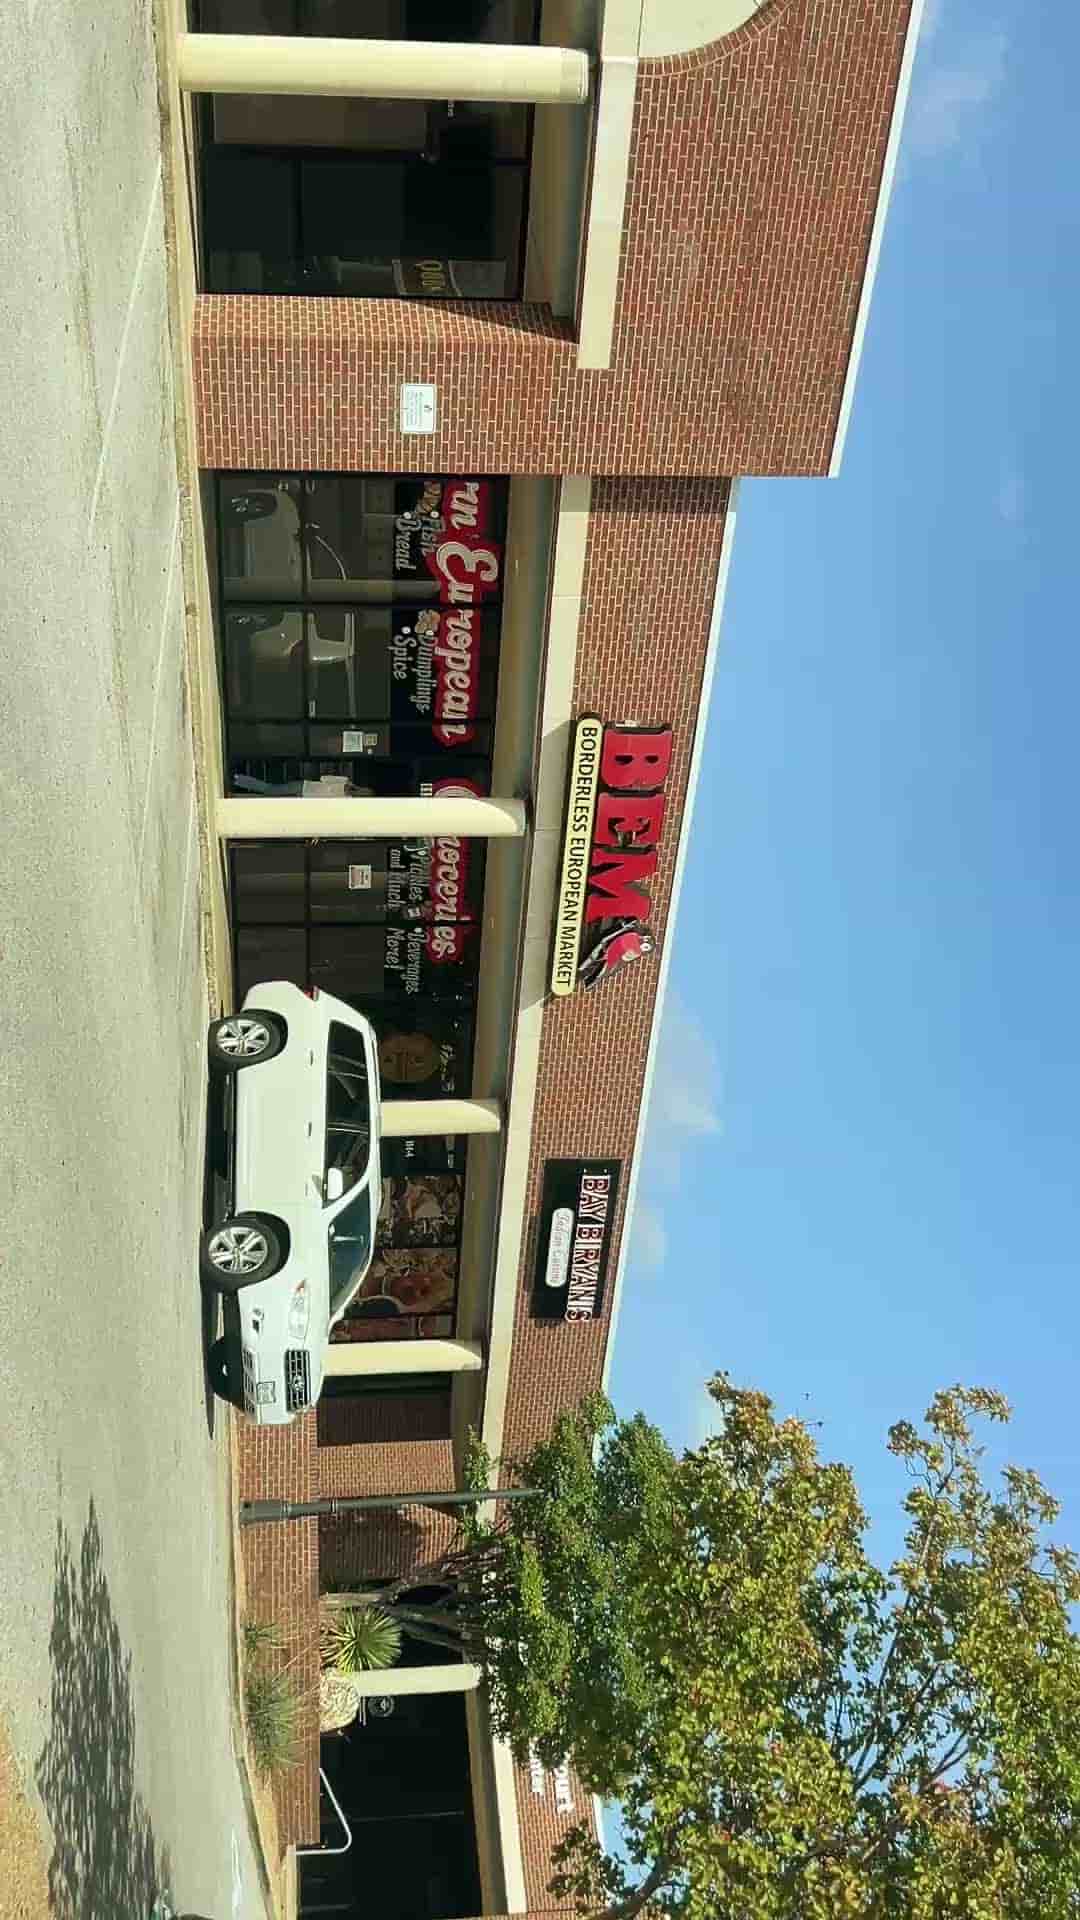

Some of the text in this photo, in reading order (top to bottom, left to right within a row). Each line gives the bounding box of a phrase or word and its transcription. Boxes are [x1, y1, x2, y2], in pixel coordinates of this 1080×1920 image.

[394, 518, 420, 570] Bread
[387, 635, 416, 681] Spice
[409, 634, 438, 713] Dumplings
[436, 542, 499, 741] European
[389, 848, 405, 869] and
[555, 727, 598, 987] BORDERLESS EUROPEAN MARKET
[584, 729, 674, 924] BEM
[384, 928, 405, 971] More!
[401, 932, 430, 994] Beverages
[564, 1175, 610, 1322] BAY BIRYANIS
